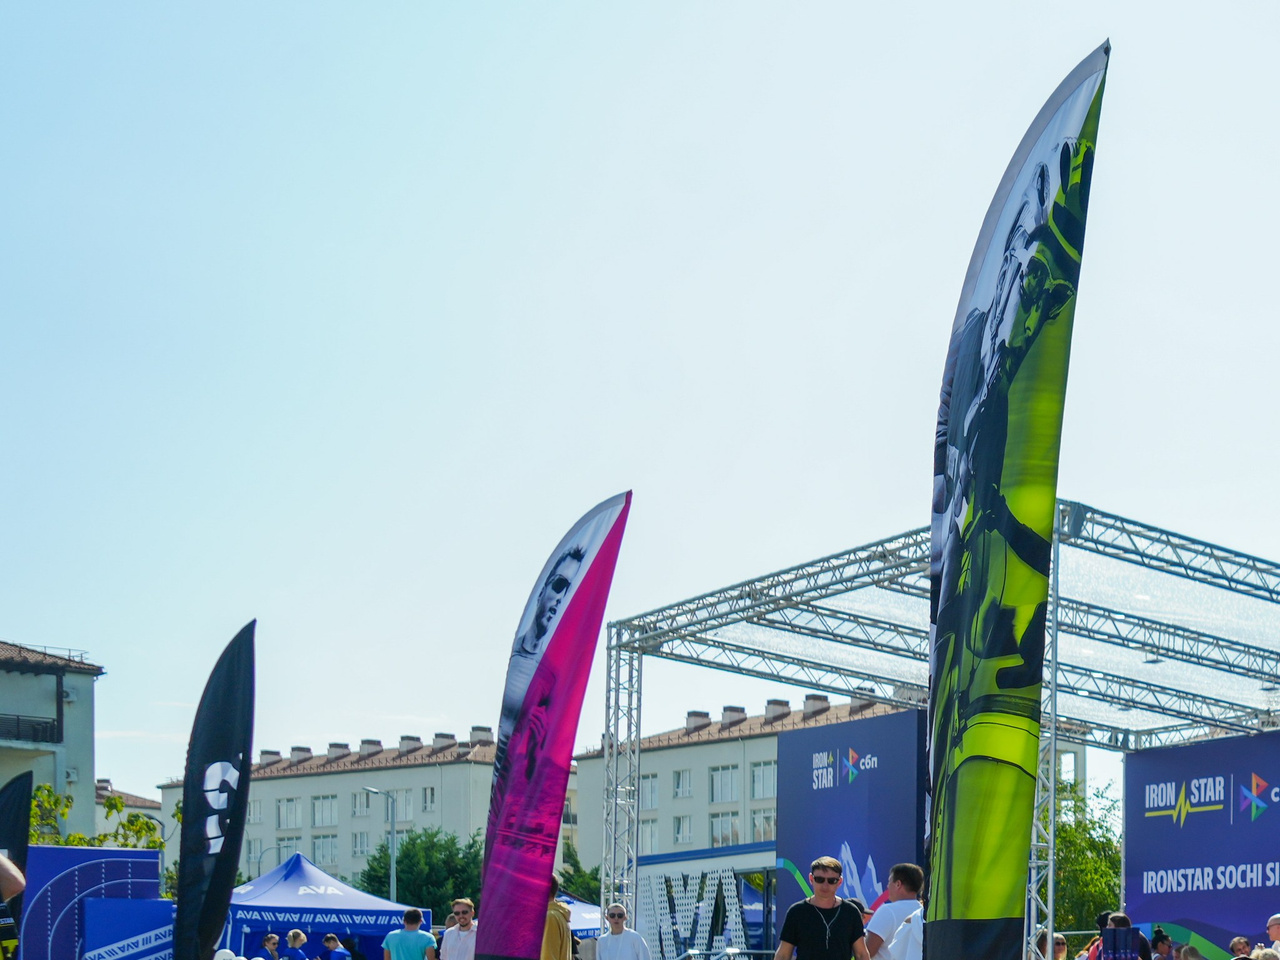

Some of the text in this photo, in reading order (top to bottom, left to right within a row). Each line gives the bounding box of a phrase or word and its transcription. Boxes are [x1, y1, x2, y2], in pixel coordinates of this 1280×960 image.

[812, 751, 828, 769] IRON
[859, 753, 878, 770] сбп
[812, 767, 834, 790] STAR
[1145, 776, 1225, 808] IRON STAR
[1143, 866, 1214, 894] IRONSTAR
[1216, 863, 1263, 890] SOCHI
[298, 886, 344, 896] AVA
[236, 910, 262, 921] AVA
[314, 914, 340, 923] AVA
